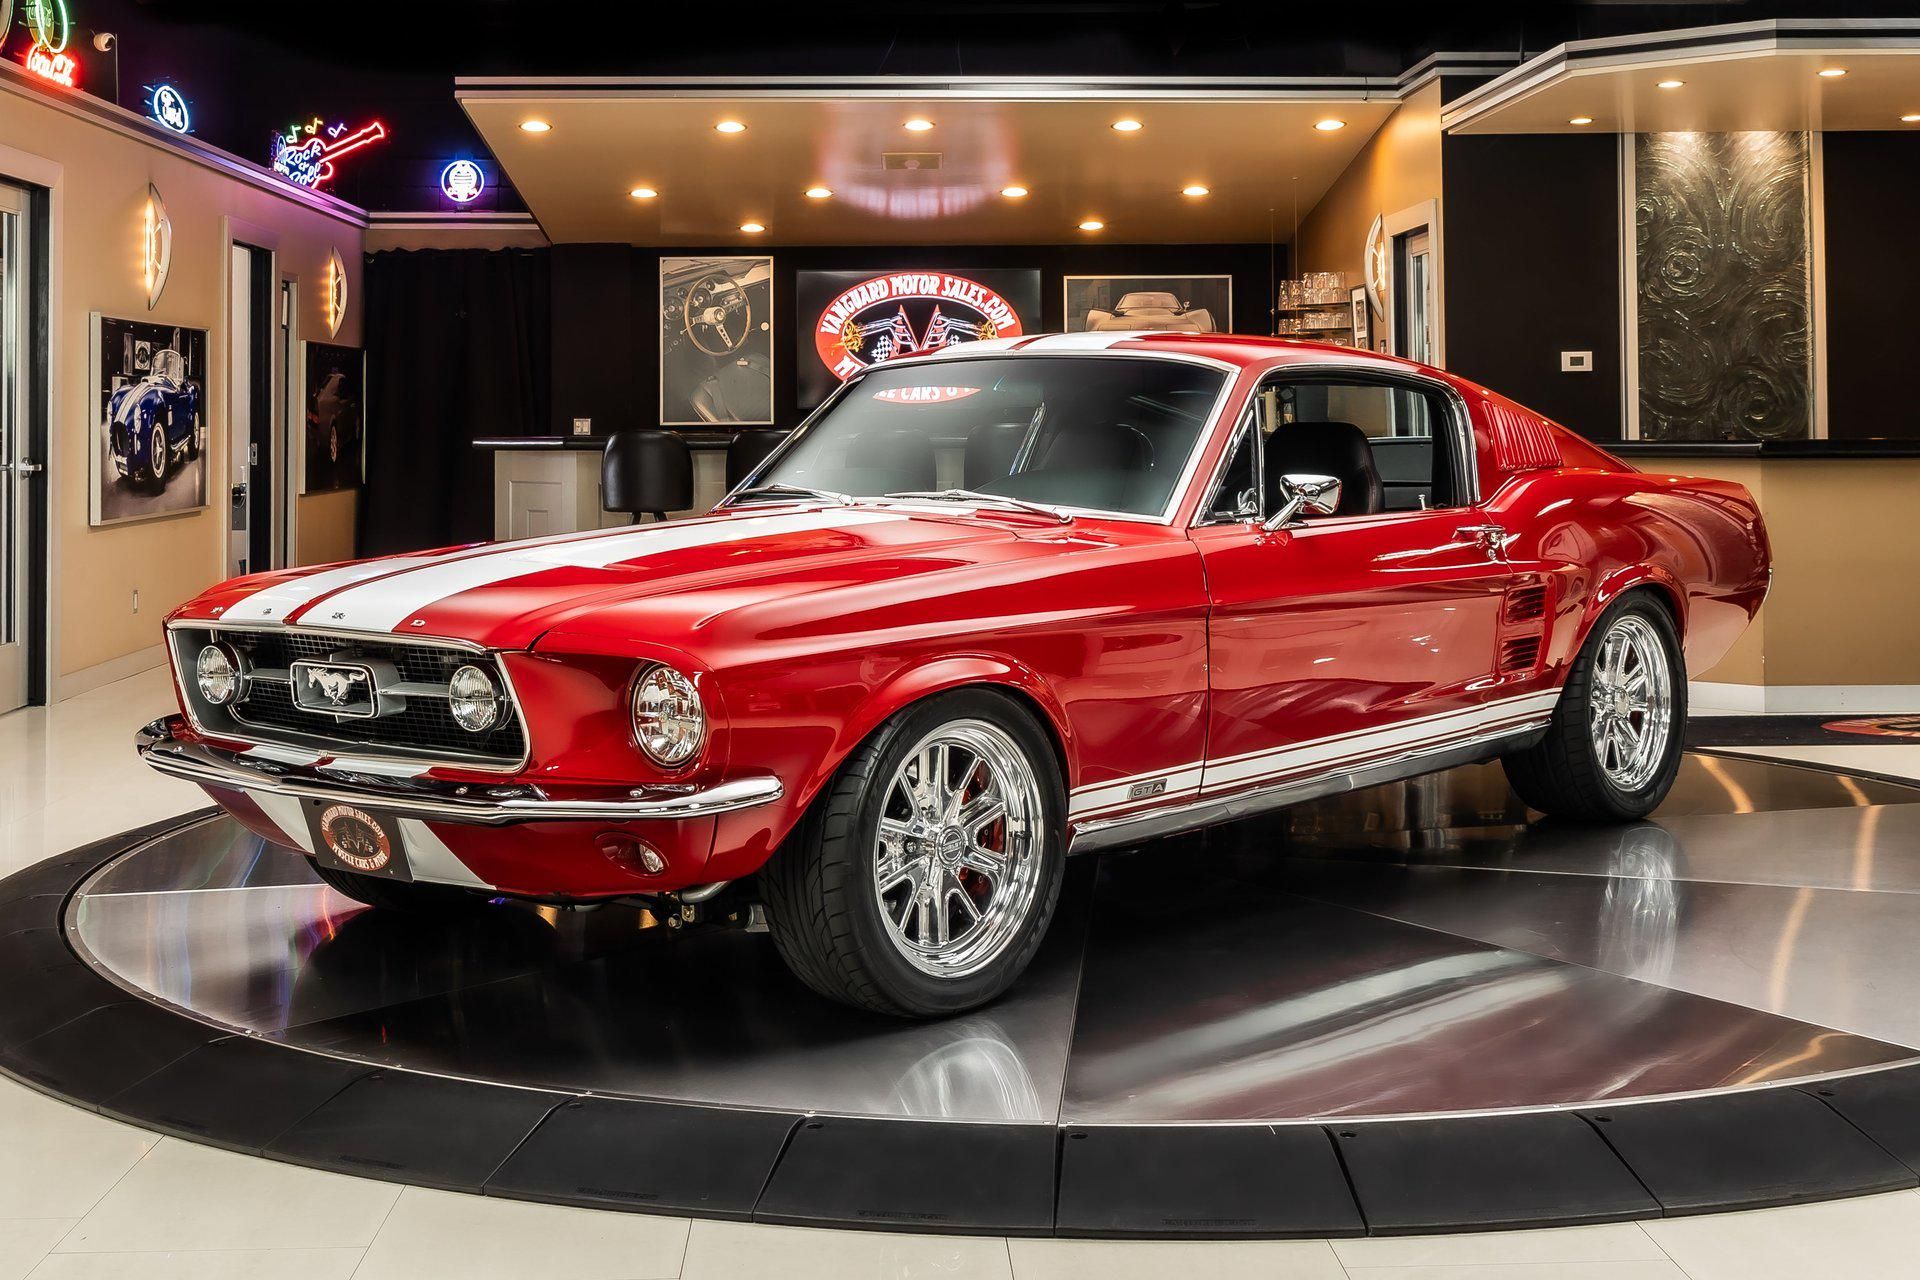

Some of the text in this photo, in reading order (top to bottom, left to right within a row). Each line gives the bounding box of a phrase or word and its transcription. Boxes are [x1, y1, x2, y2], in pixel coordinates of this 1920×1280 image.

[286, 140, 321, 166] Rock
[821, 274, 1016, 335] VANGUARD MOTOR SALES.COM
[1133, 783, 1164, 797] GTA
[354, 808, 385, 838] SALES.COM
[332, 843, 355, 866] MUSCLE
[354, 857, 370, 870] CARS
[373, 850, 388, 867] MORE
